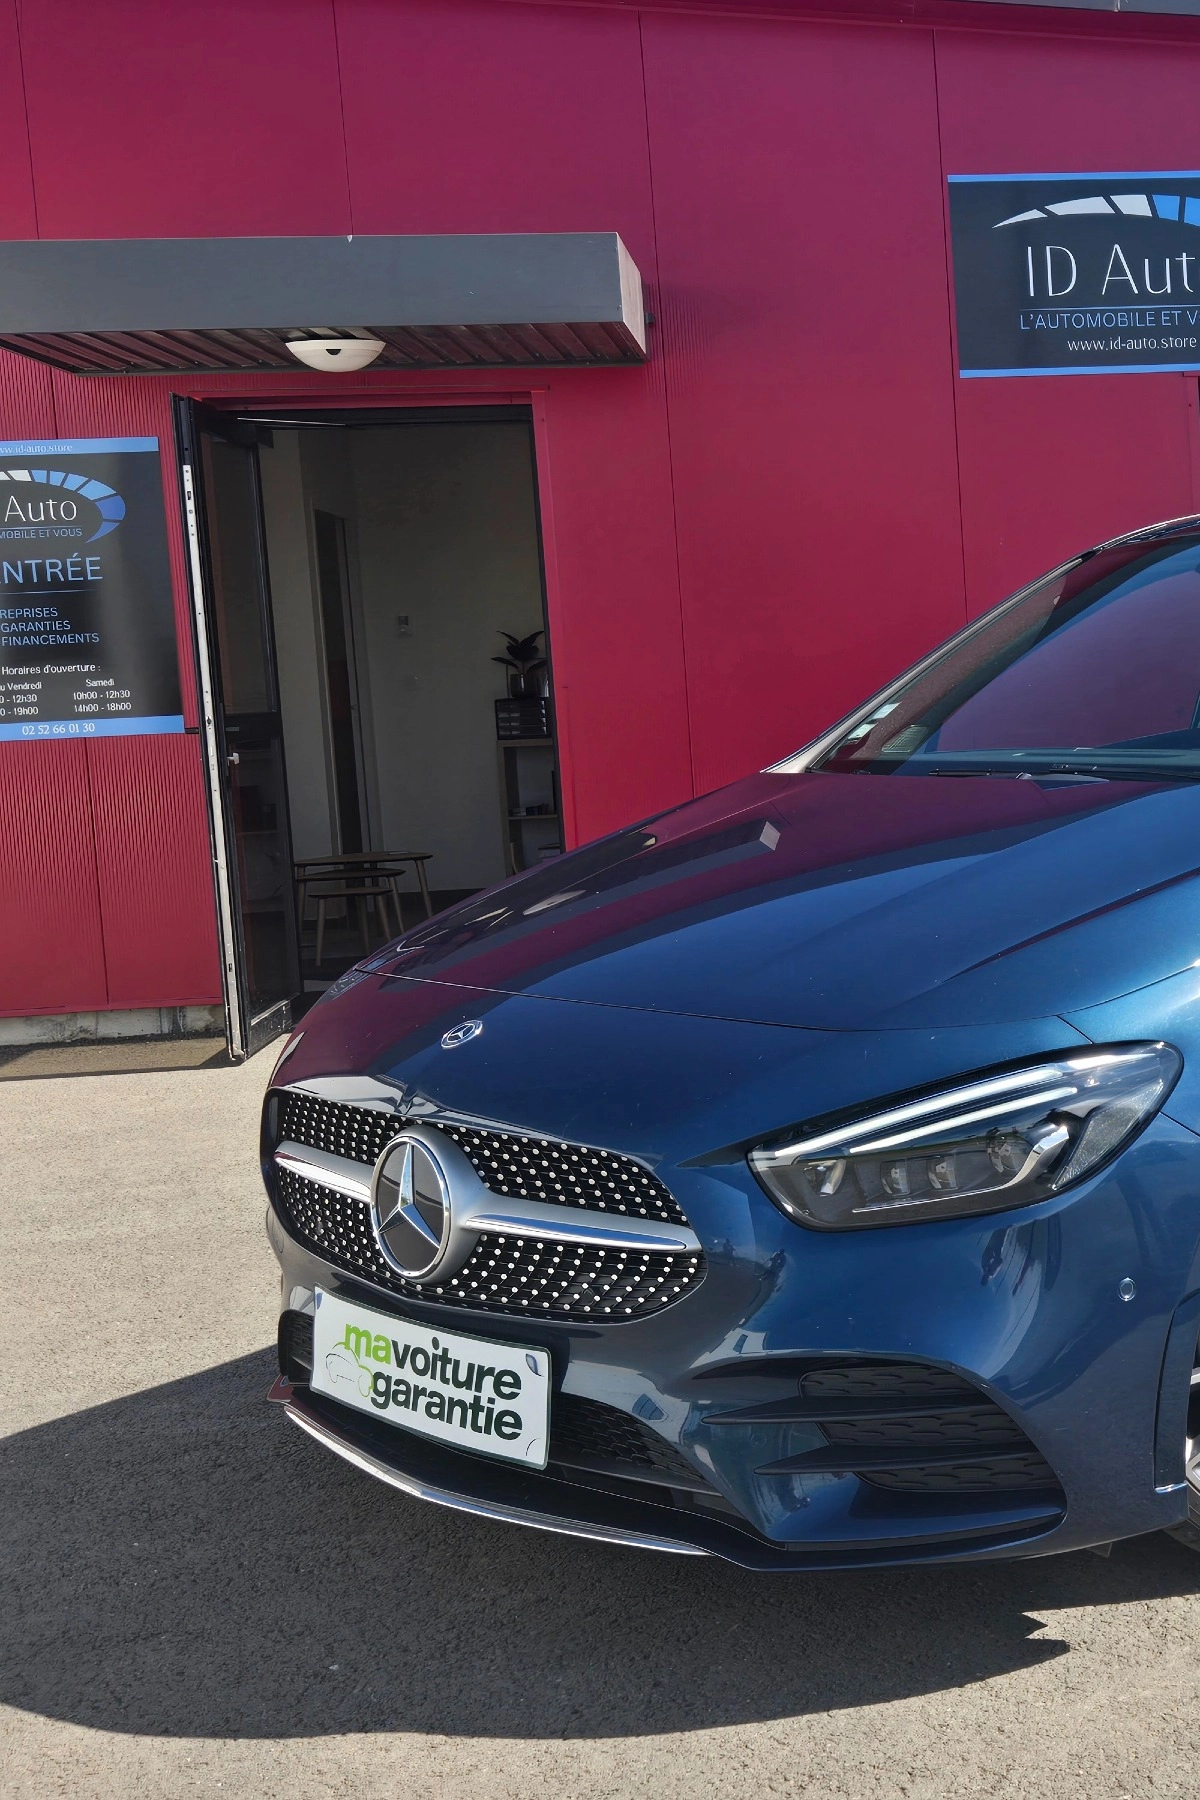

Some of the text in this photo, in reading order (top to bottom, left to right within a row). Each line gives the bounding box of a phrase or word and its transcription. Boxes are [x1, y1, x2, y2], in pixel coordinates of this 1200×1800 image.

[1027, 245, 1077, 297] ID
[1020, 311, 1156, 330] L'AUTOMOBILE
[1161, 310, 1182, 327] ET
[1067, 335, 1198, 351] www.id-auto.store
[4, 495, 77, 522] Auto
[39, 529, 50, 538] ET
[53, 528, 83, 537] VOUS
[0, 553, 103, 584] NTRÉE
[0, 607, 58, 619] REPRISES
[1, 620, 71, 633] GARANTIES
[1, 633, 100, 647] FINANCEMENTS
[1, 666, 41, 676] Horaires
[43, 664, 96, 674] d'ouverture
[6, 682, 42, 691] Vendredi
[85, 678, 115, 687] Samedi
[12, 694, 38, 703] 12h30
[73, 691, 98, 700] 10h00
[105, 690, 131, 699] 12h30
[14, 706, 39, 716] 19h00
[74, 703, 99, 713] 14h00
[106, 702, 132, 712] 18h00
[22, 722, 95, 735] 02 52 66 01 30
[371, 1370, 523, 1441] garantie
